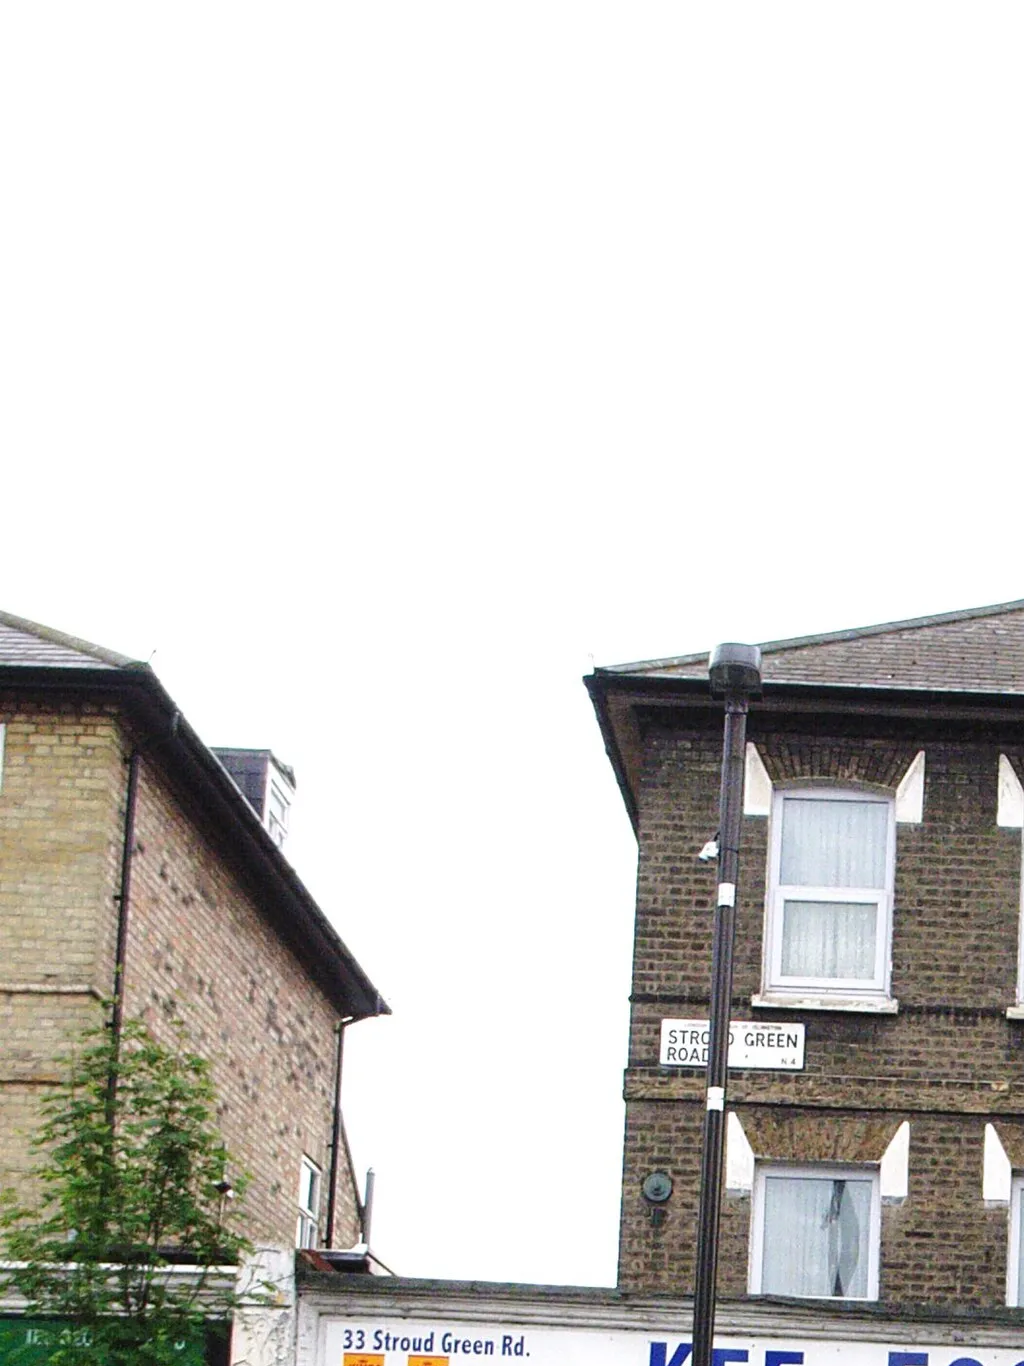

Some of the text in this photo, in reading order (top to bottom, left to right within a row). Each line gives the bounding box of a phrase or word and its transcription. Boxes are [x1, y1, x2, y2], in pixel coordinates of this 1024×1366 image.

[744, 1032, 798, 1048] GREEN
[343, 1329, 530, 1357] 33 Stroud Green Rd.
